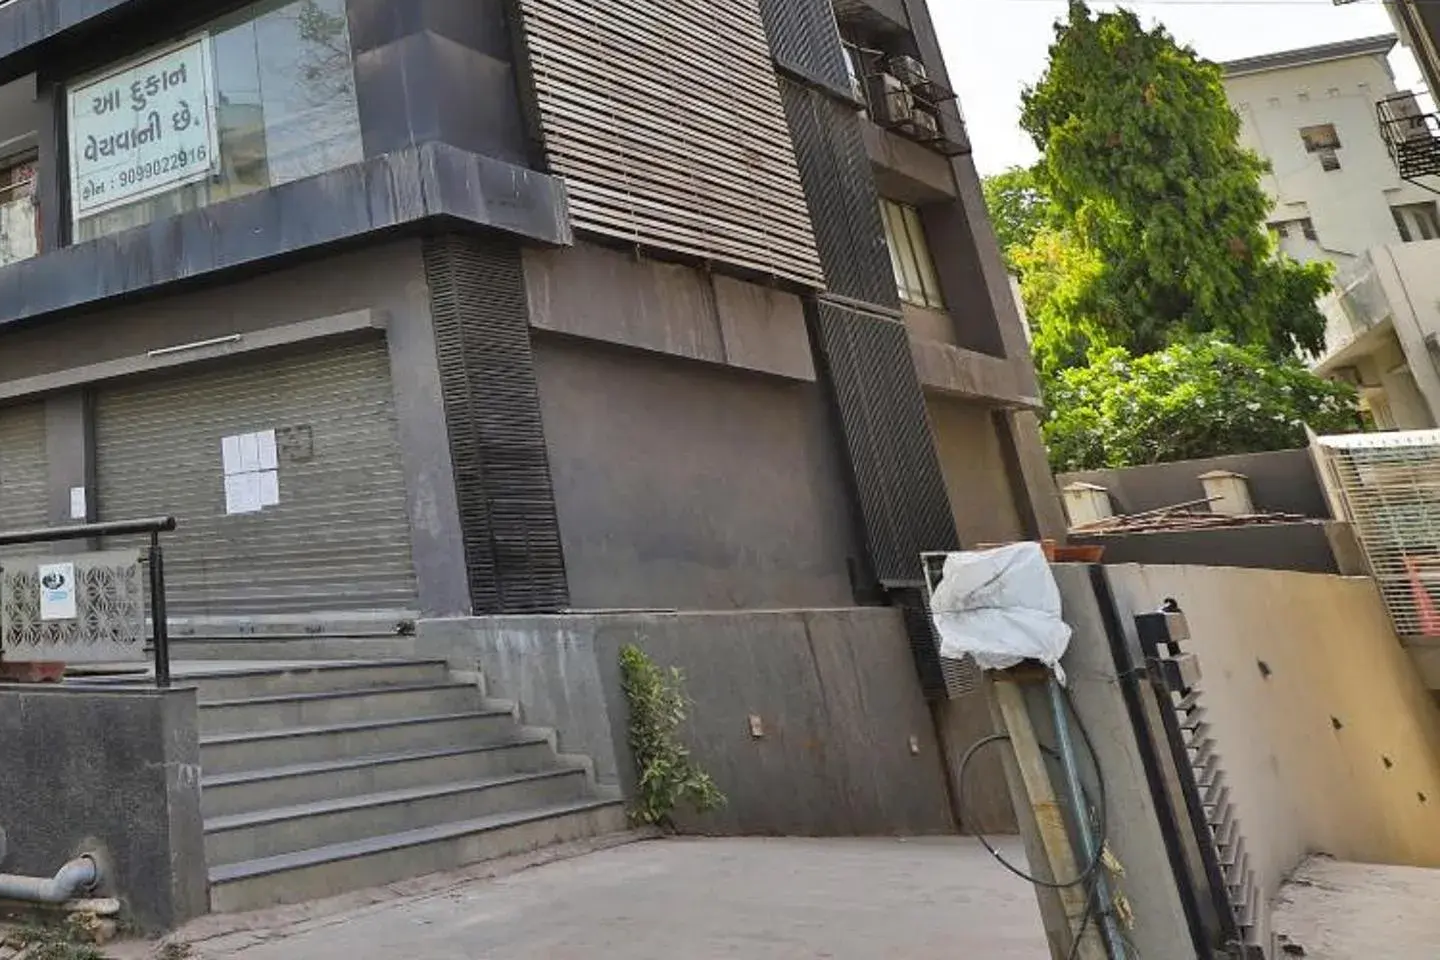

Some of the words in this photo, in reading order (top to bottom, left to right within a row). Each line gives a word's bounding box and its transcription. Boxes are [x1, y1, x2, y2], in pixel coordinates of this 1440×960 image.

[92, 89, 120, 115] આ
[130, 62, 187, 111] દુકાન
[119, 145, 206, 187] 9099022916
